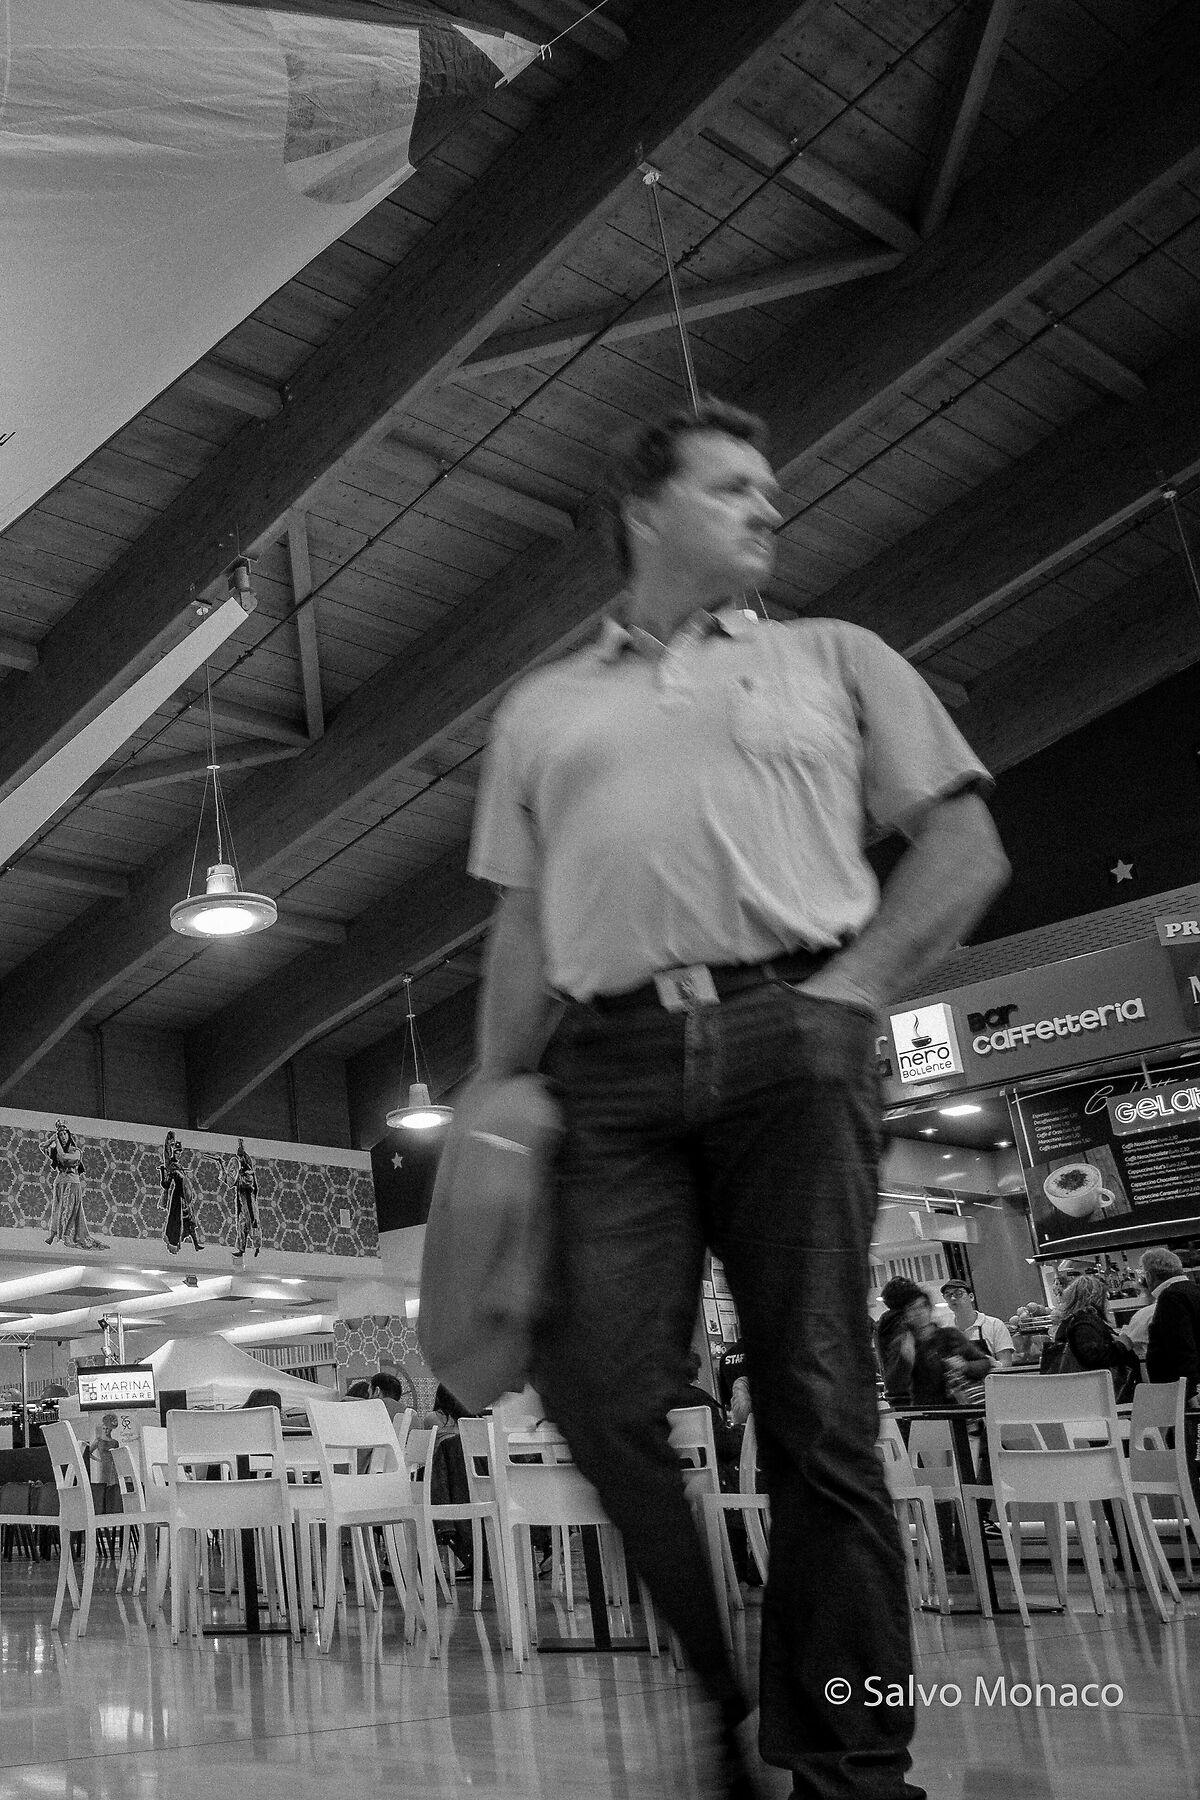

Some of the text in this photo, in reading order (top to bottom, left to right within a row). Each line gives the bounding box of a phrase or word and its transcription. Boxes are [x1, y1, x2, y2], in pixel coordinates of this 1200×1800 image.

[899, 1046, 950, 1070] nero
[100, 1380, 151, 1391] MARINA
[101, 1391, 152, 1400] MILITARE
